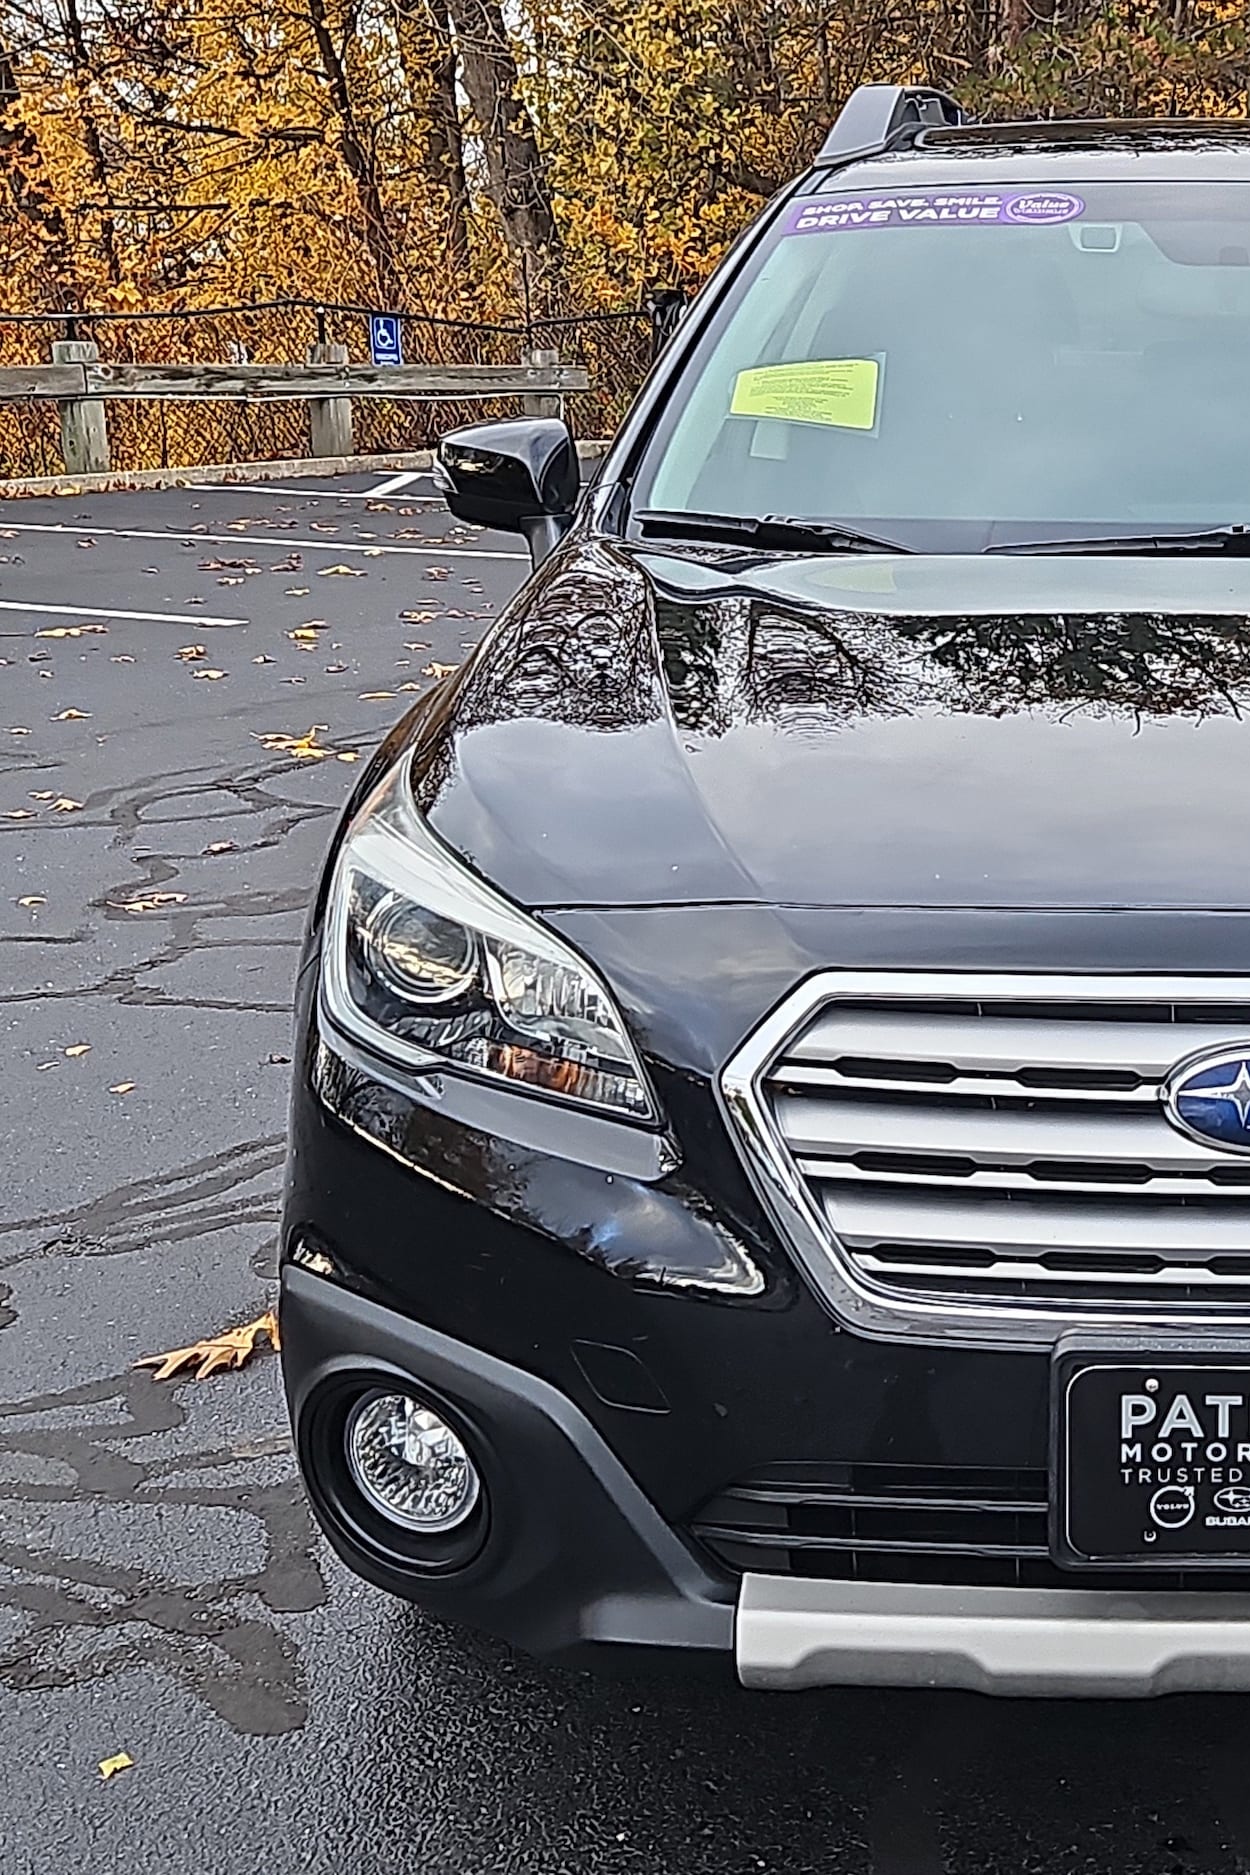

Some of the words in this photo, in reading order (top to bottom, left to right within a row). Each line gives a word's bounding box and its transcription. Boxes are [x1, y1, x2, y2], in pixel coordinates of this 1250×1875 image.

[796, 210, 890, 229] DRIVE
[899, 207, 1001, 221] VALUE
[1121, 1468, 1243, 1485] TRUSTED
